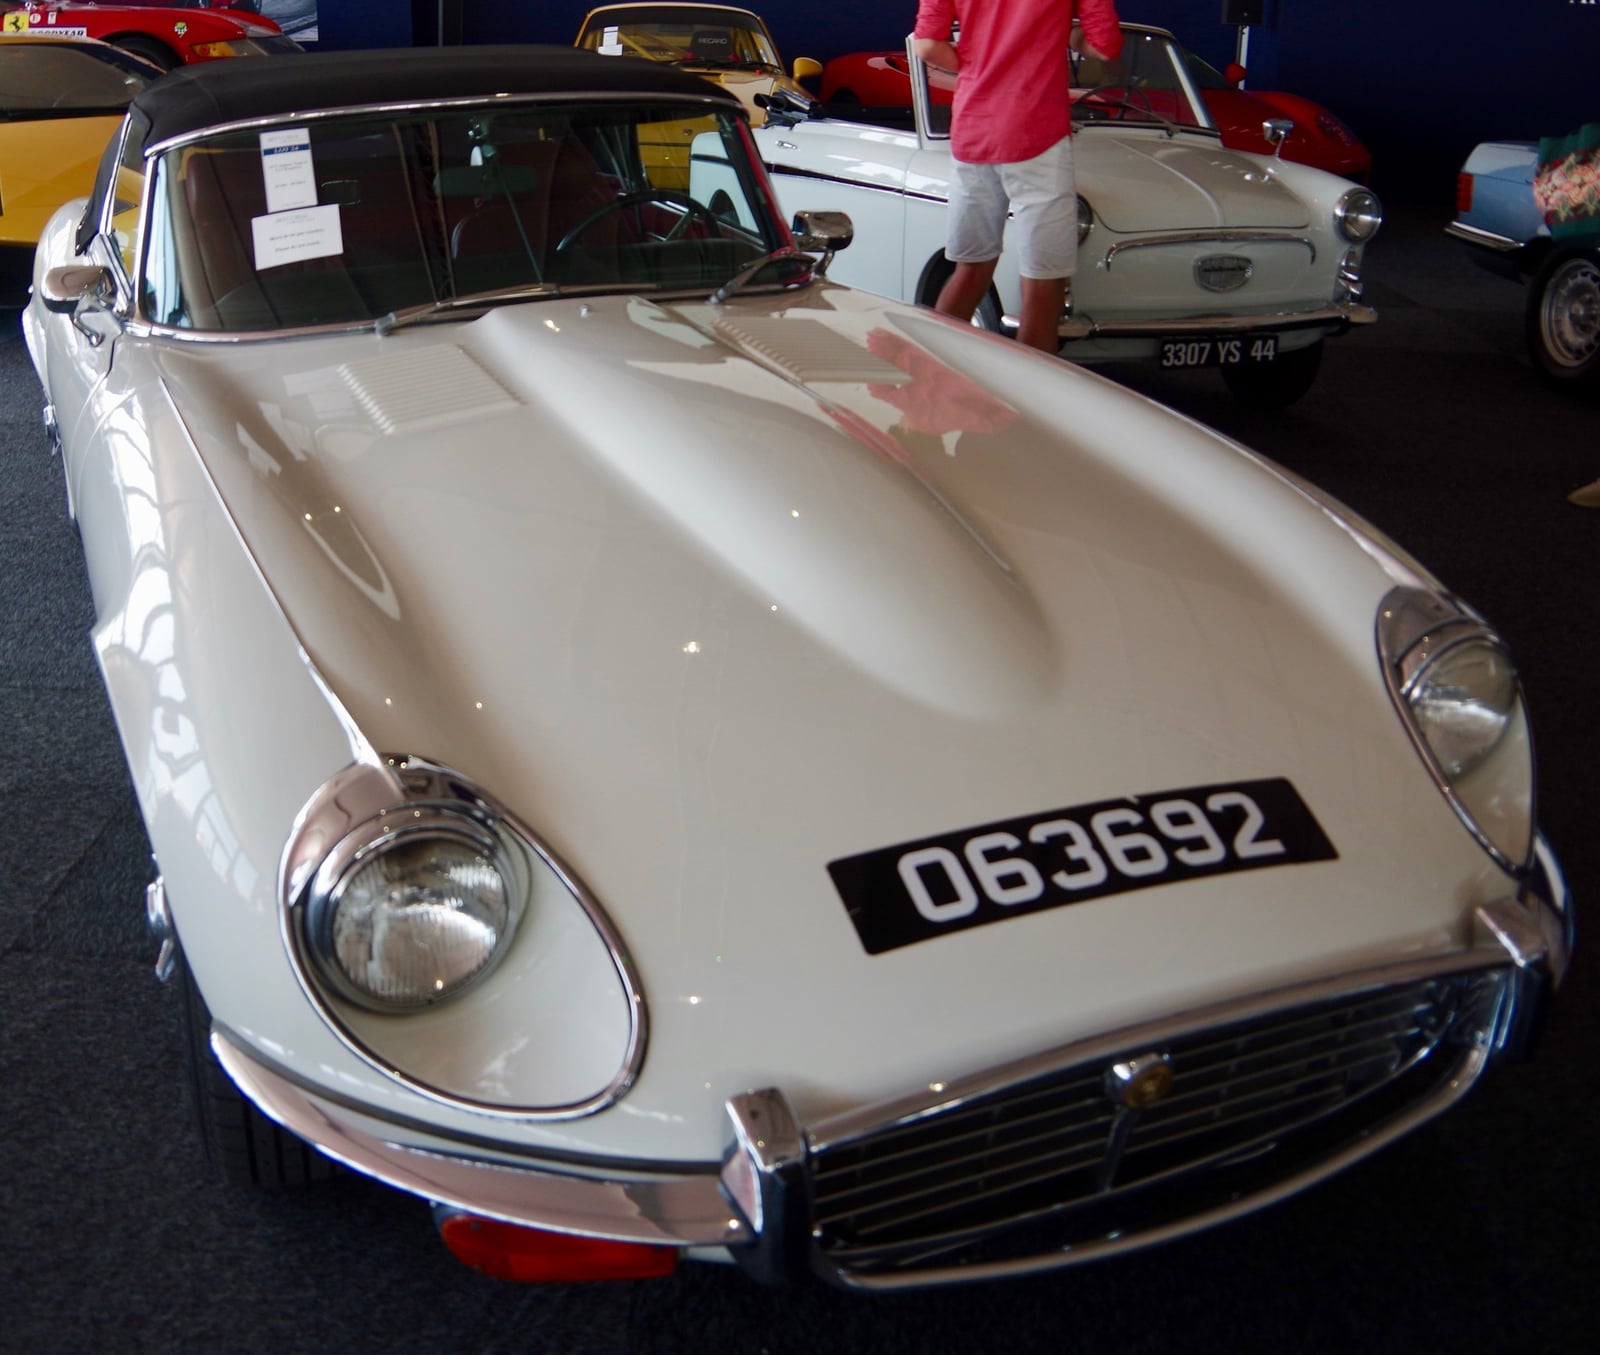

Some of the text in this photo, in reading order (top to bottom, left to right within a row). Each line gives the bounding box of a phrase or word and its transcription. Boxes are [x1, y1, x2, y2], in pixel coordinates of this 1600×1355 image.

[1162, 339, 1275, 366] 3307 YS 44
[898, 792, 1286, 922] 063692
